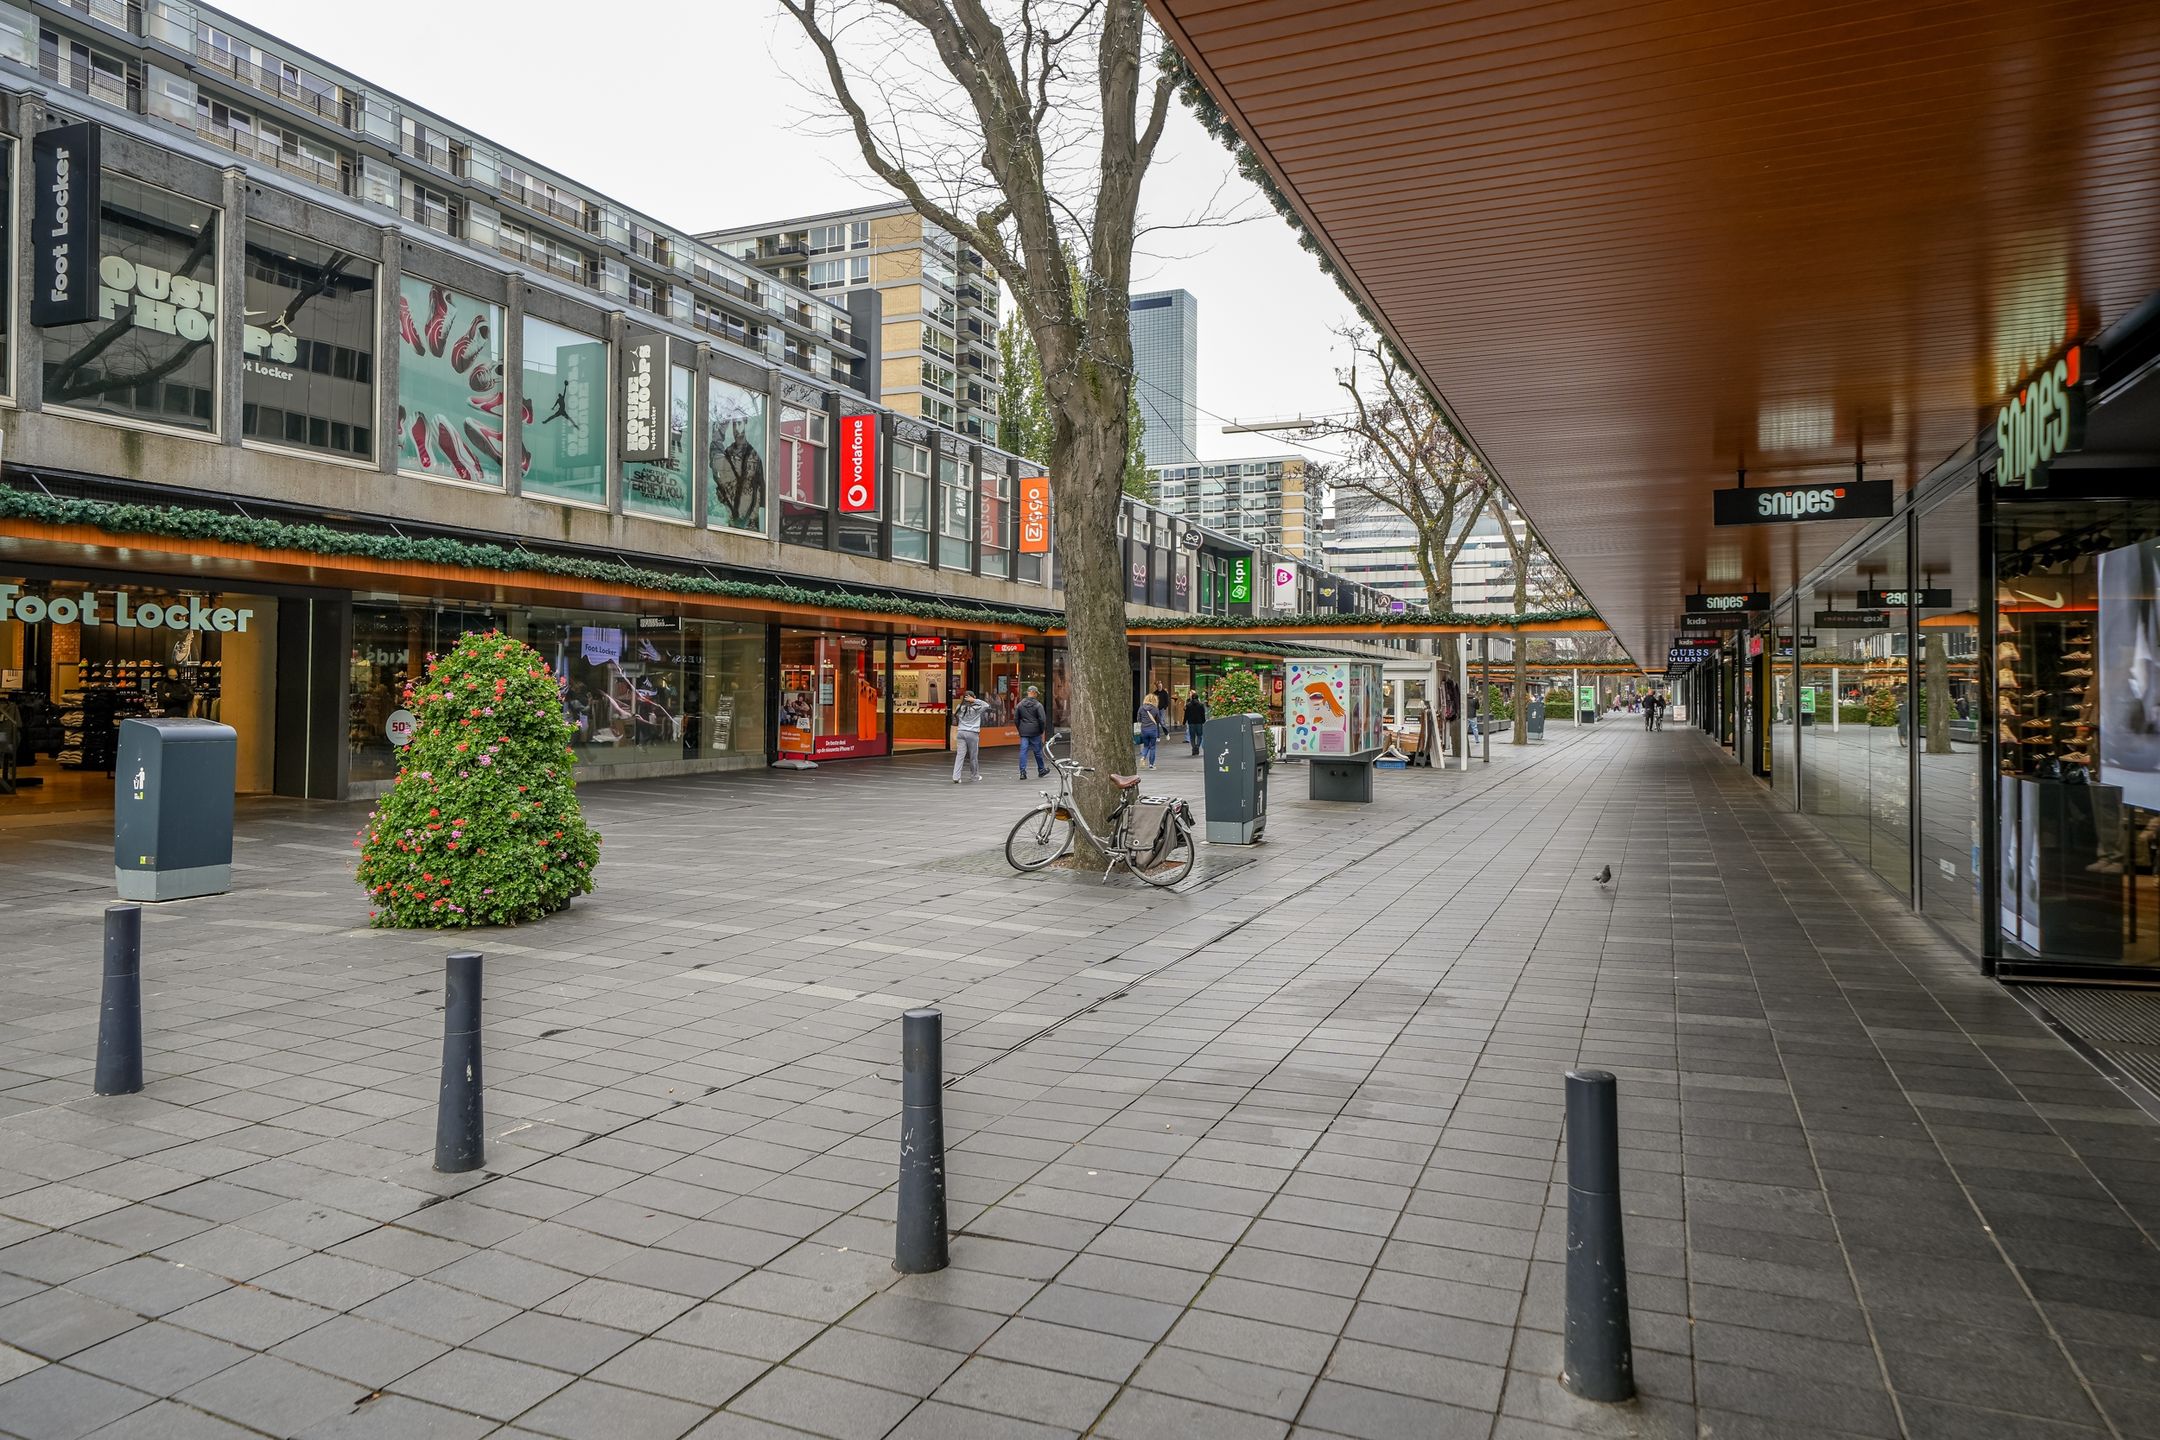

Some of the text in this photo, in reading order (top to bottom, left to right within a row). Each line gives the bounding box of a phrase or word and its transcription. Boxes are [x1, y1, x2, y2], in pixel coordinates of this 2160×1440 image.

[51, 147, 70, 302] Foot Locker
[255, 363, 294, 381] Locker
[638, 344, 651, 451] OF HOOPS
[626, 376, 639, 452] HOUSE
[1997, 358, 2070, 491] snipes
[851, 420, 863, 482] vodafone
[633, 470, 677, 487] SHOULD
[1758, 489, 1835, 519] snipes
[1234, 560, 1246, 583] kpn
[116, 592, 254, 632] Locker
[1706, 596, 1744, 610] snipes
[1687, 617, 1707, 625] kids
[584, 643, 599, 653] Foot
[1670, 649, 1709, 657] GUESS
